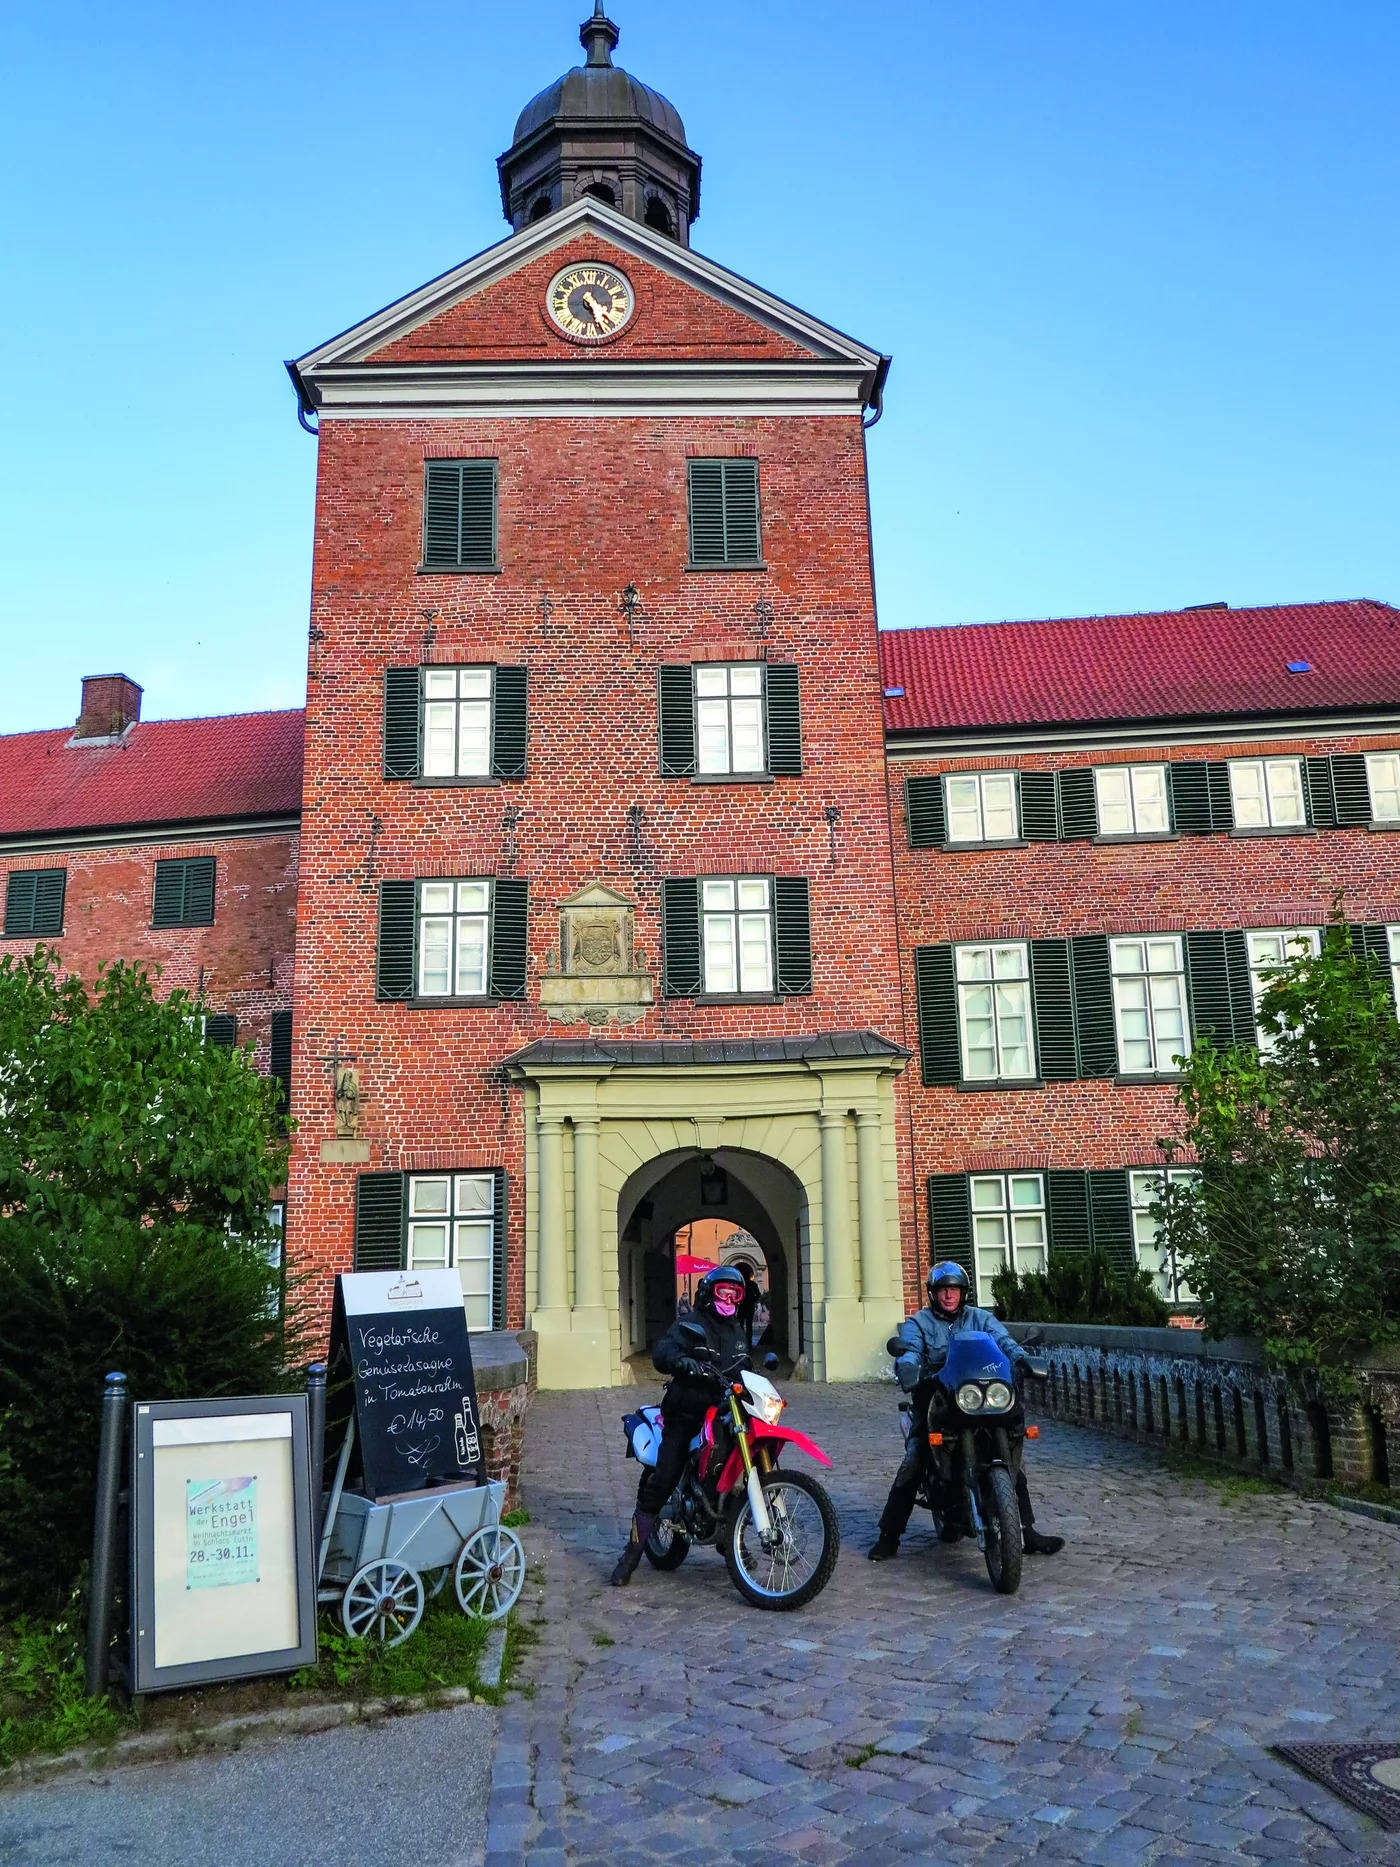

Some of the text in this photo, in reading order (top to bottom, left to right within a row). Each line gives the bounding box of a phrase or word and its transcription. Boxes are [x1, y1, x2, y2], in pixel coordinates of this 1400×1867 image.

[358, 1326, 443, 1356] Vegetarische
[357, 1354, 455, 1379] Gemüselasagne
[364, 1376, 464, 1407] in Tomatenrahm
[189, 1499, 254, 1516] Werkstatt
[196, 1509, 254, 1529] der Engel
[193, 1528, 252, 1540] Weihnachtsmarkt
[190, 1545, 254, 1563] 28.-30.11.
